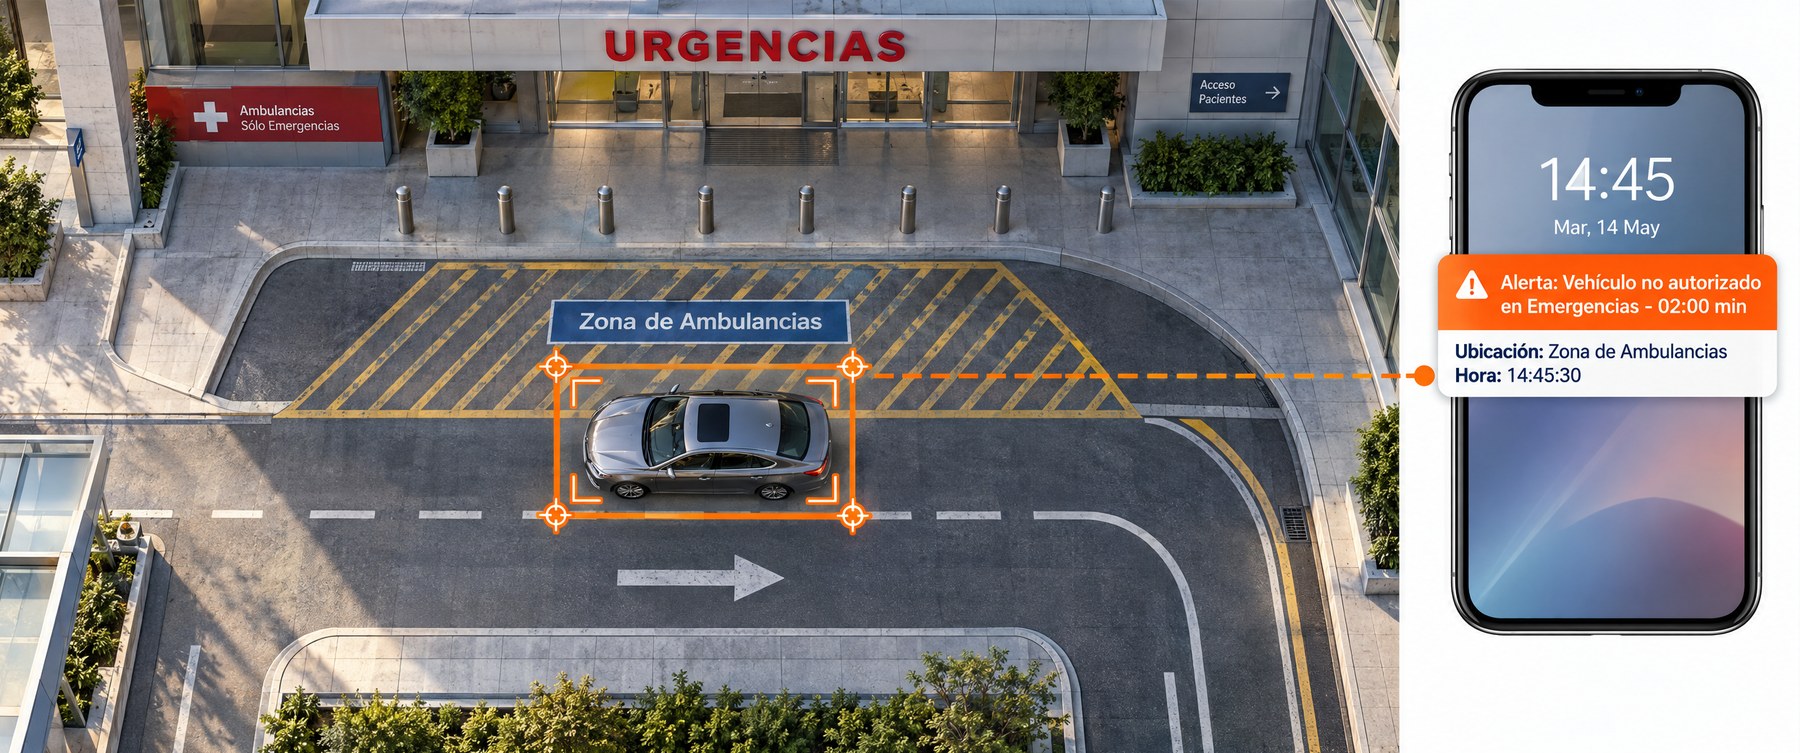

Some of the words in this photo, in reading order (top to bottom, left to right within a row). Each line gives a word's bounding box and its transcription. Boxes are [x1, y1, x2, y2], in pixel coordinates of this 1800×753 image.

[605, 29, 905, 63] URGENCIAS
[1199, 79, 1236, 90] Acceso
[1198, 93, 1247, 104] Pacientes
[239, 104, 315, 117] Ambulancias
[241, 119, 266, 131] Sólo
[268, 120, 340, 134] Emergencias
[1540, 157, 1675, 202] 14:45
[1554, 219, 1591, 238] Mar,
[1597, 219, 1618, 235] 14
[1624, 219, 1661, 239] May
[1500, 273, 1558, 291] Alerta:
[1562, 273, 1637, 291] Vehículo
[1641, 278, 1664, 291] no
[1668, 273, 1762, 291] autorizado
[1500, 301, 1522, 314] en
[1527, 297, 1640, 318] Emergencias
[1658, 297, 1710, 314] 02:00
[1714, 297, 1747, 314] min
[1455, 342, 1544, 359] Ubicación:
[1548, 343, 1590, 359] Zona
[1595, 342, 1616, 359] de
[1620, 342, 1728, 359] Ambulancias
[1455, 367, 1502, 383] Hora:
[1507, 367, 1582, 383] 14:45:30
